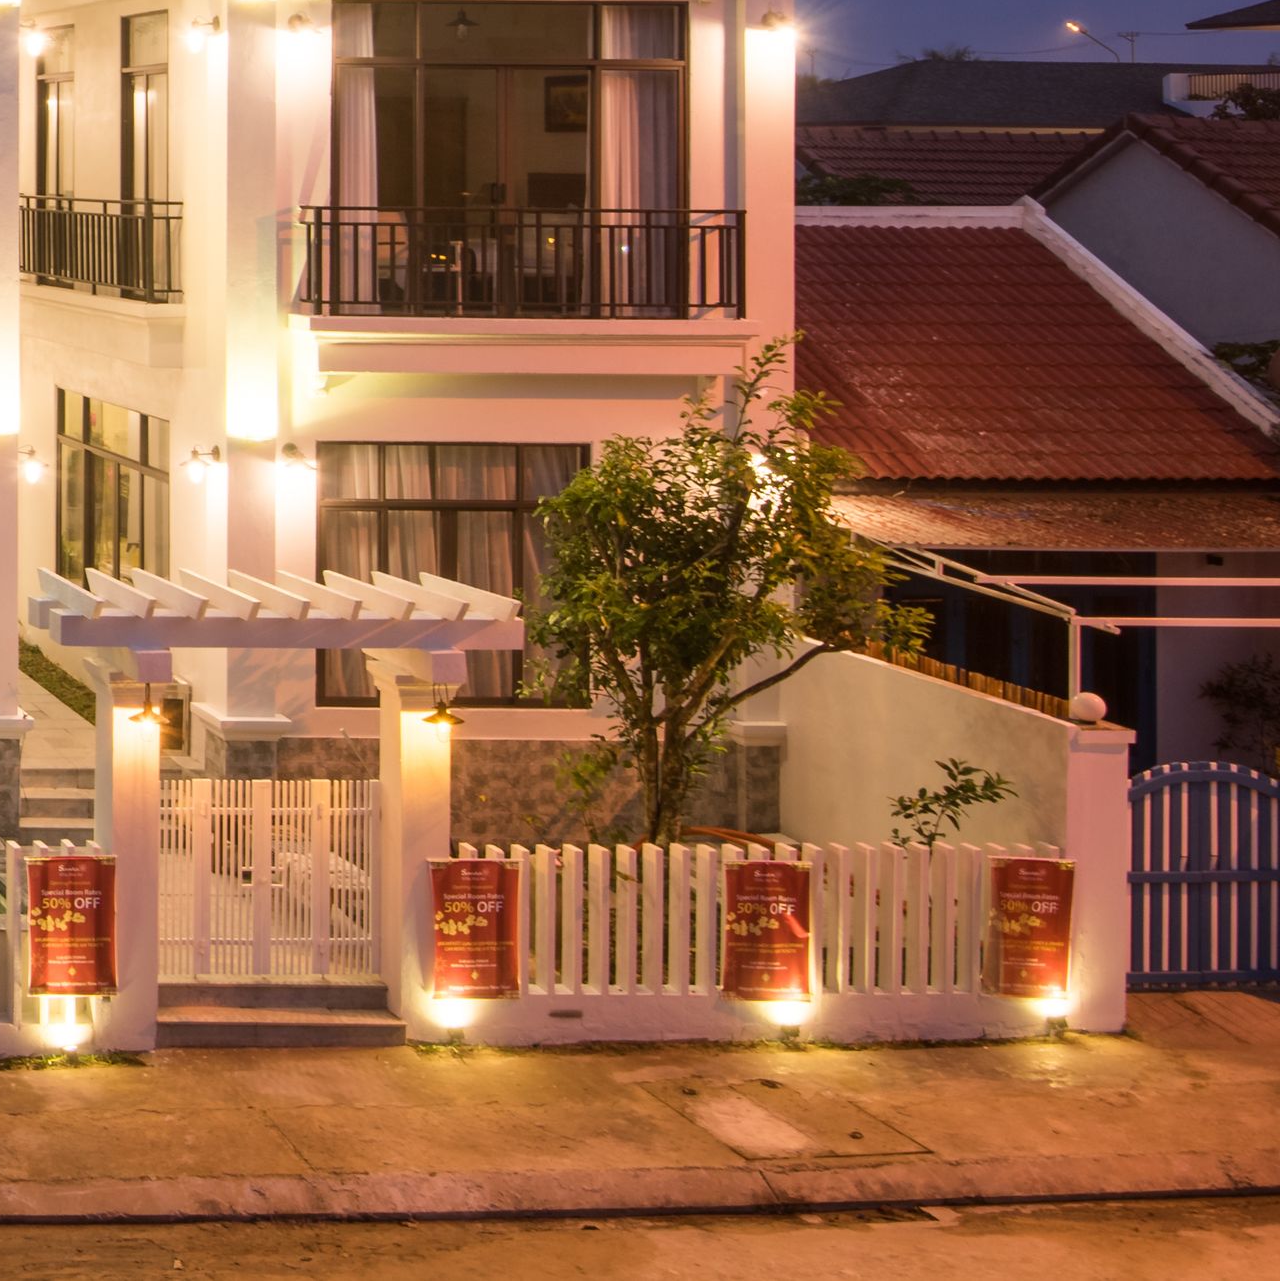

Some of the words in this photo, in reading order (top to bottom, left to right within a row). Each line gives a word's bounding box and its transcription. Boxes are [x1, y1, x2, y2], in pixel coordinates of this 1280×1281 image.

[41, 889, 64, 897] Special
[42, 897, 72, 909] 50%
[74, 897, 101, 909] OFF
[444, 901, 475, 913] 50%
[477, 901, 503, 913] OFF
[737, 902, 767, 915] 50%
[769, 902, 796, 916] OFF
[1000, 899, 1030, 911] 50%
[1031, 900, 1059, 914] OFF
